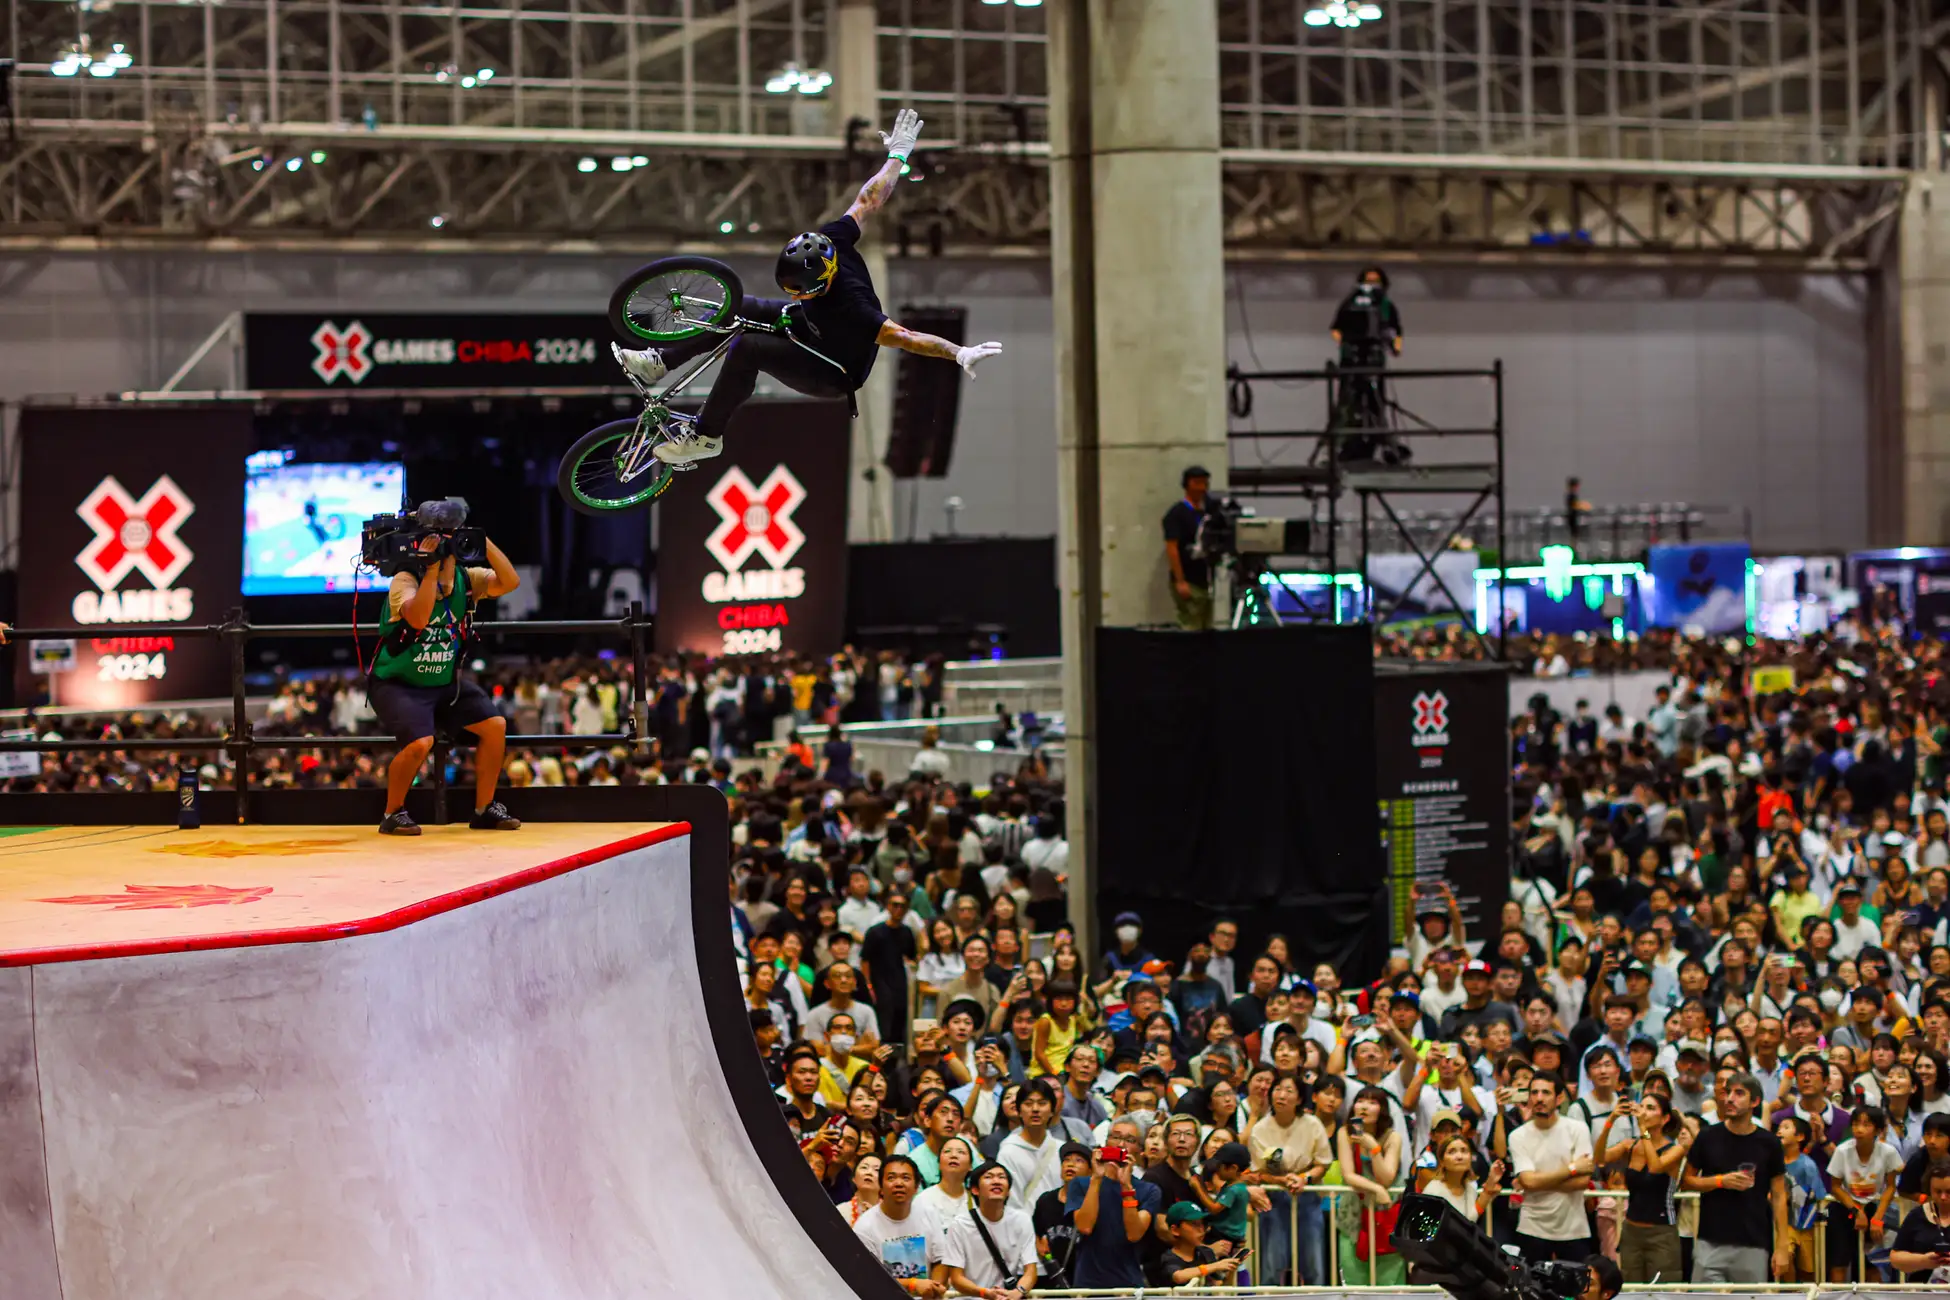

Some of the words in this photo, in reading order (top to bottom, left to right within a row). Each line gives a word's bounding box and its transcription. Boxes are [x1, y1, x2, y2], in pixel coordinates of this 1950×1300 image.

[373, 339, 455, 363] GAMES
[457, 340, 533, 363] CHIBA
[534, 338, 596, 363] 2024
[702, 567, 806, 603] GAMES
[72, 587, 193, 624] GAMES
[718, 604, 789, 630] CHIBA
[722, 628, 782, 655] 2024
[97, 653, 167, 681] 2024
[417, 665, 446, 674] CHIB
